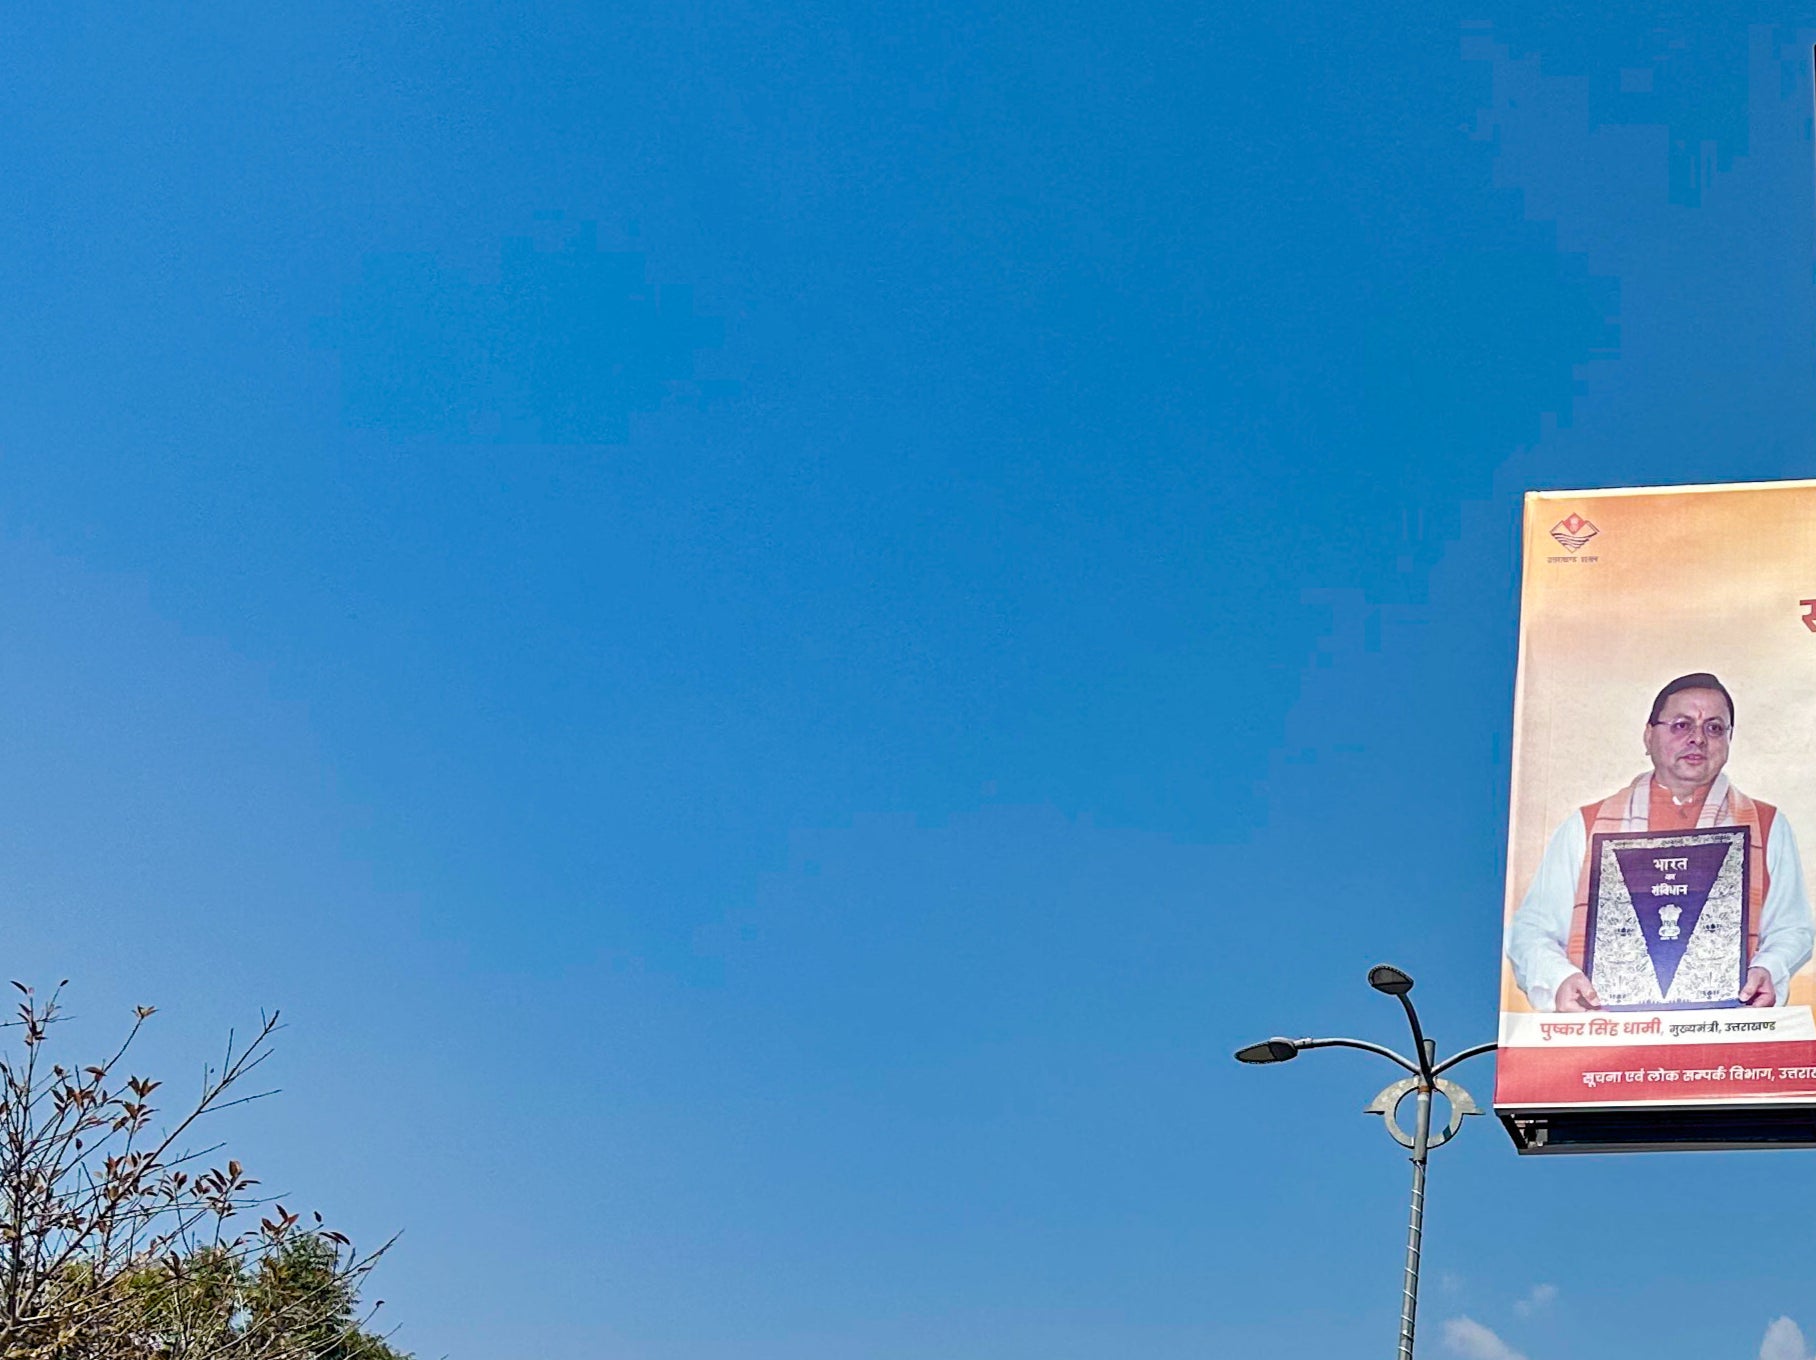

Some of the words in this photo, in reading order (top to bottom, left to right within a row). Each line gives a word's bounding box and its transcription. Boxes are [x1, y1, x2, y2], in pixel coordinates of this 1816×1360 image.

[1653, 857, 1688, 872] भारत
[1651, 883, 1688, 897] संविधान
[1540, 1022, 1585, 1041] पुष्कर
[1588, 1018, 1619, 1037] सिंह
[1623, 1017, 1663, 1037] धामी,
[1669, 1019, 1721, 1037] मुख्यमंत्री,
[1724, 1021, 1776, 1034] उत्तराखण्ड
[1582, 1070, 1624, 1089] सूचना
[1625, 1067, 1645, 1084] एवं
[1647, 1068, 1680, 1084] लोक
[1682, 1066, 1726, 1083] सम्पर्क
[1729, 1065, 1775, 1084] विभाग,
